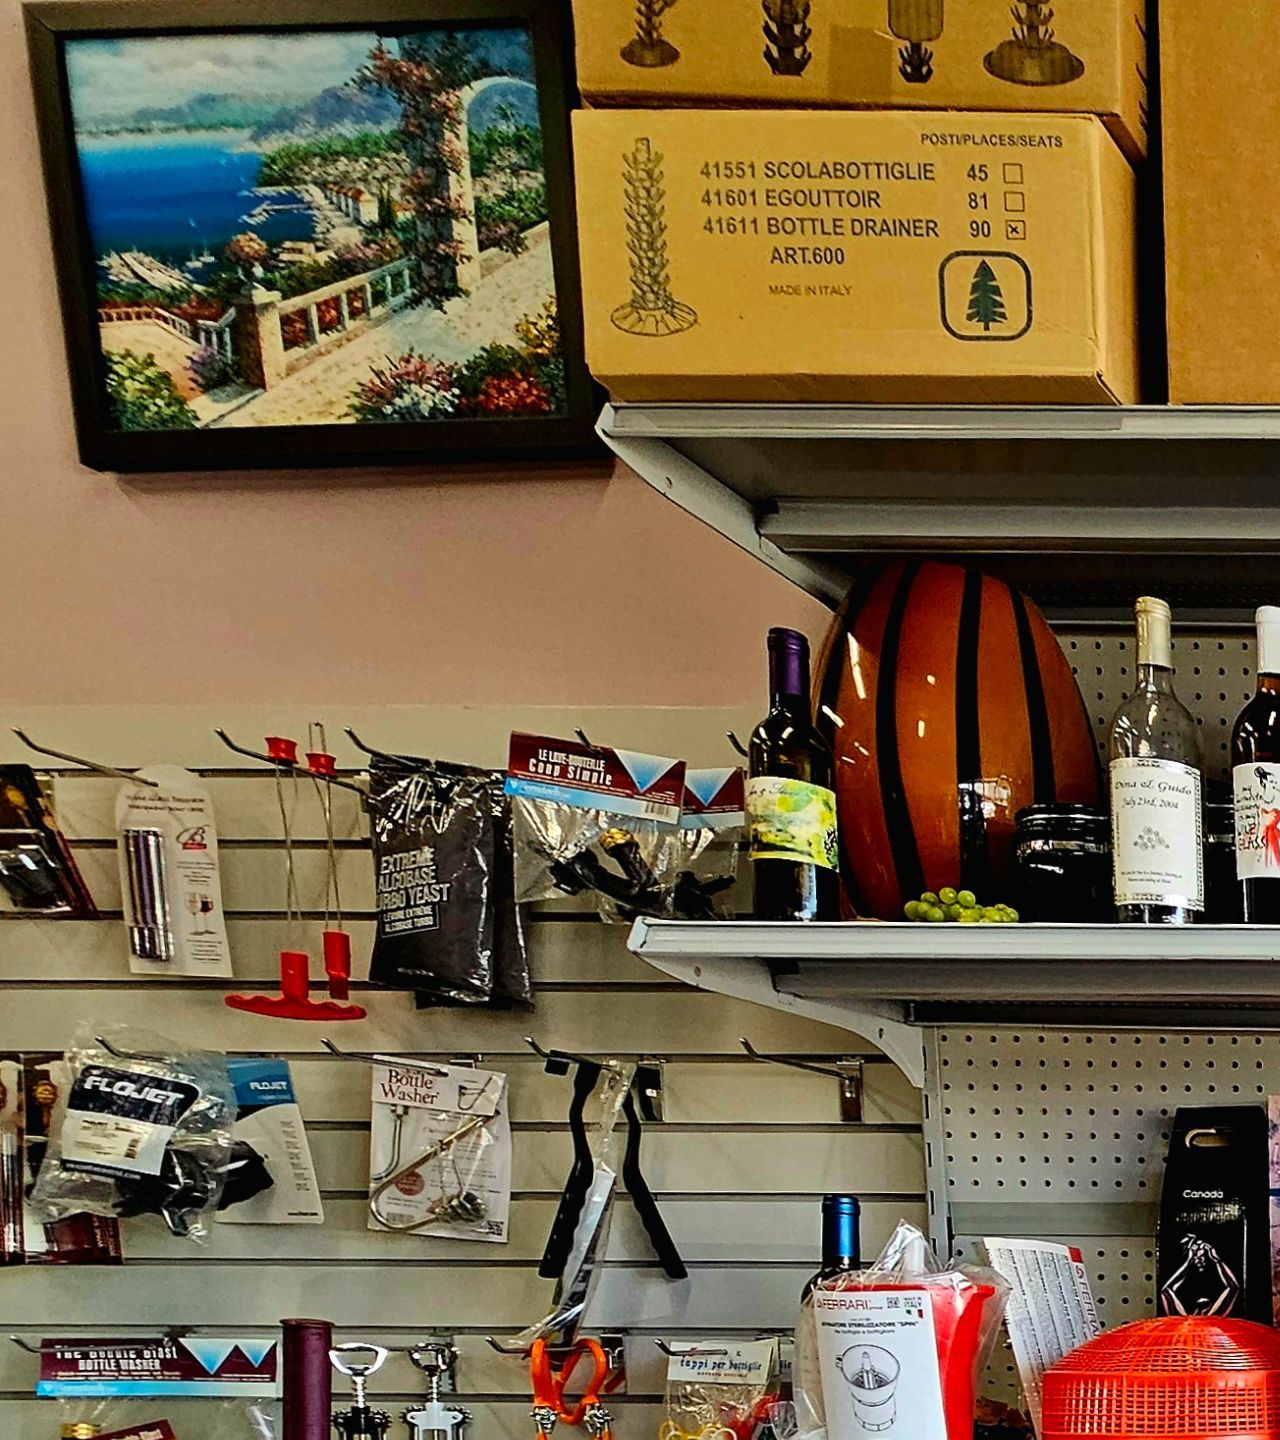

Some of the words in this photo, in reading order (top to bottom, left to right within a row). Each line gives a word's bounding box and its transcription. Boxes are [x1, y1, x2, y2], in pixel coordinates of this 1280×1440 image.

[920, 132, 1063, 149] POSTI/PLACES/SEATS
[700, 160, 756, 179] 41551
[763, 160, 935, 182] SCOLABOTTIGLIE
[966, 163, 989, 182] 45
[700, 188, 757, 208] 41601
[765, 188, 882, 209] EGOUTTOIR
[967, 191, 990, 211] 81
[702, 217, 759, 236] 41611
[766, 217, 845, 237] BOTTLE
[850, 218, 940, 239] DRAINER
[969, 220, 991, 240] 90
[770, 246, 845, 266] ART.600
[769, 285, 801, 297] MADE
[804, 285, 816, 297] IN
[818, 285, 852, 297] ITALY
[539, 749, 548, 760] LE
[529, 759, 561, 777] Coup
[567, 765, 613, 786] Simple
[1158, 781, 1192, 795] Guido
[380, 846, 435, 874] EXTREME
[377, 866, 437, 893] ALCOBASE
[376, 889, 406, 910] URBO
[408, 884, 451, 906] YEAST
[250, 1081, 287, 1091] FLOJET
[388, 1068, 433, 1090] Bottle
[84, 1076, 185, 1106] FLOJET
[380, 1083, 440, 1105] Washer
[1182, 1189, 1224, 1199] Canada
[822, 1299, 869, 1310] FERRARI
[78, 1359, 117, 1371] BOTTLE
[119, 1359, 161, 1371] WASHER
[680, 1358, 708, 1370] tappi
[711, 1360, 727, 1371] per
